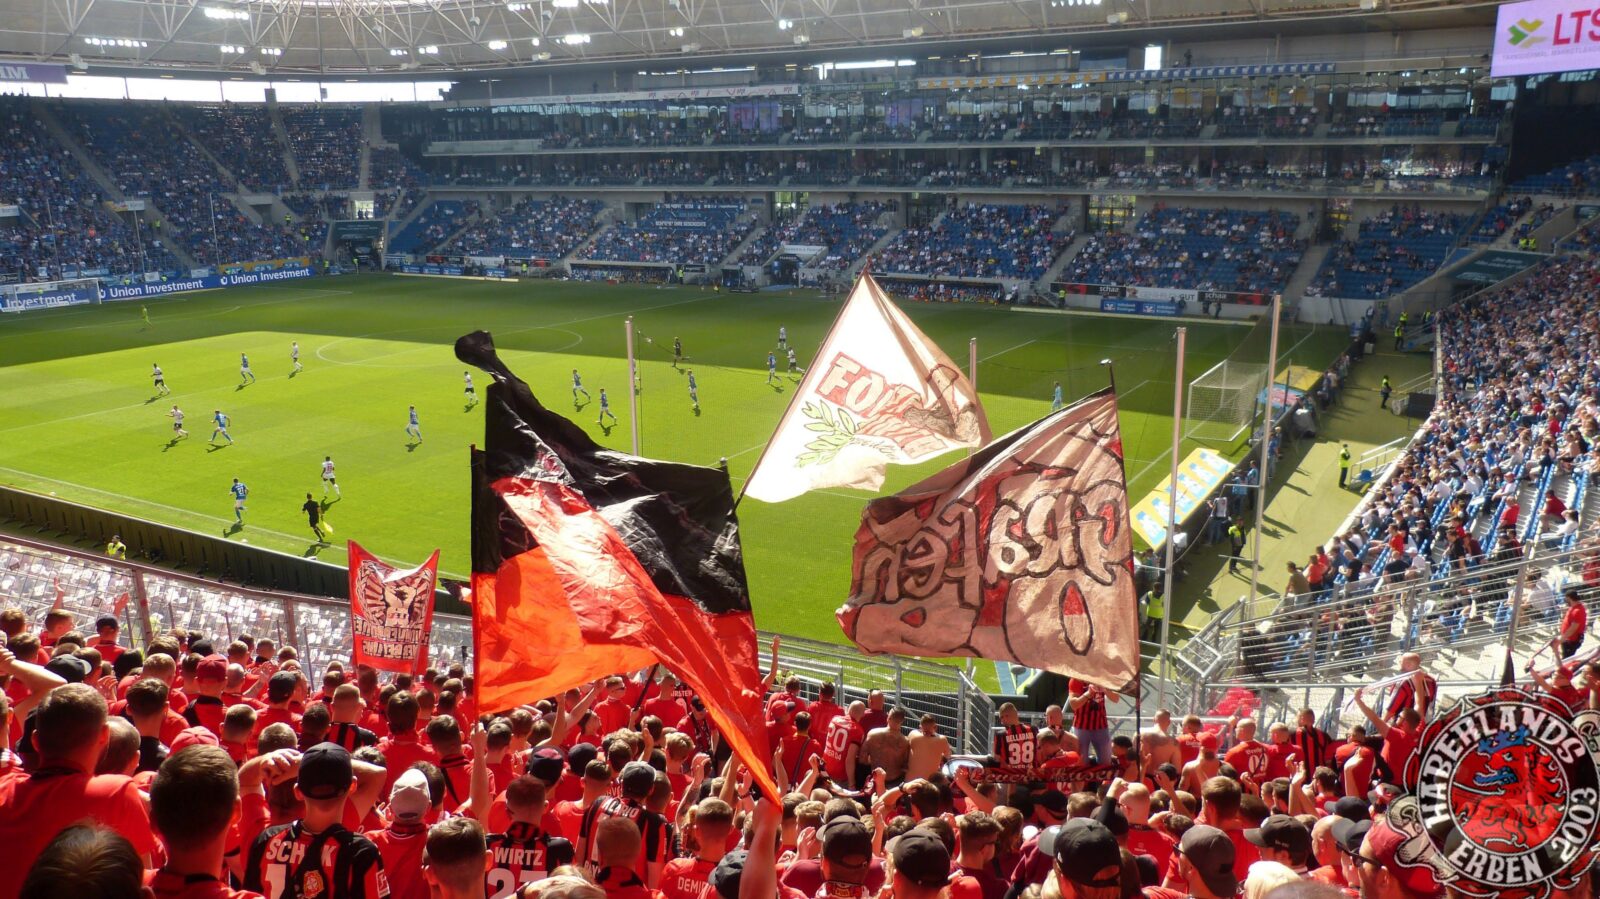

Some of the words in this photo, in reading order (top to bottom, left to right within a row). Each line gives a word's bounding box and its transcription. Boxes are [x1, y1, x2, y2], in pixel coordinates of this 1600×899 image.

[1553, 7, 1600, 46] LTS
[231, 274, 258, 284] Union
[260, 268, 310, 282] Investment
[110, 284, 142, 299] Union
[145, 279, 204, 295] Investment
[825, 722, 848, 752] 20
[1008, 741, 1034, 765] 38
[266, 838, 337, 867] SCHK
[494, 847, 543, 866] WIRTZ
